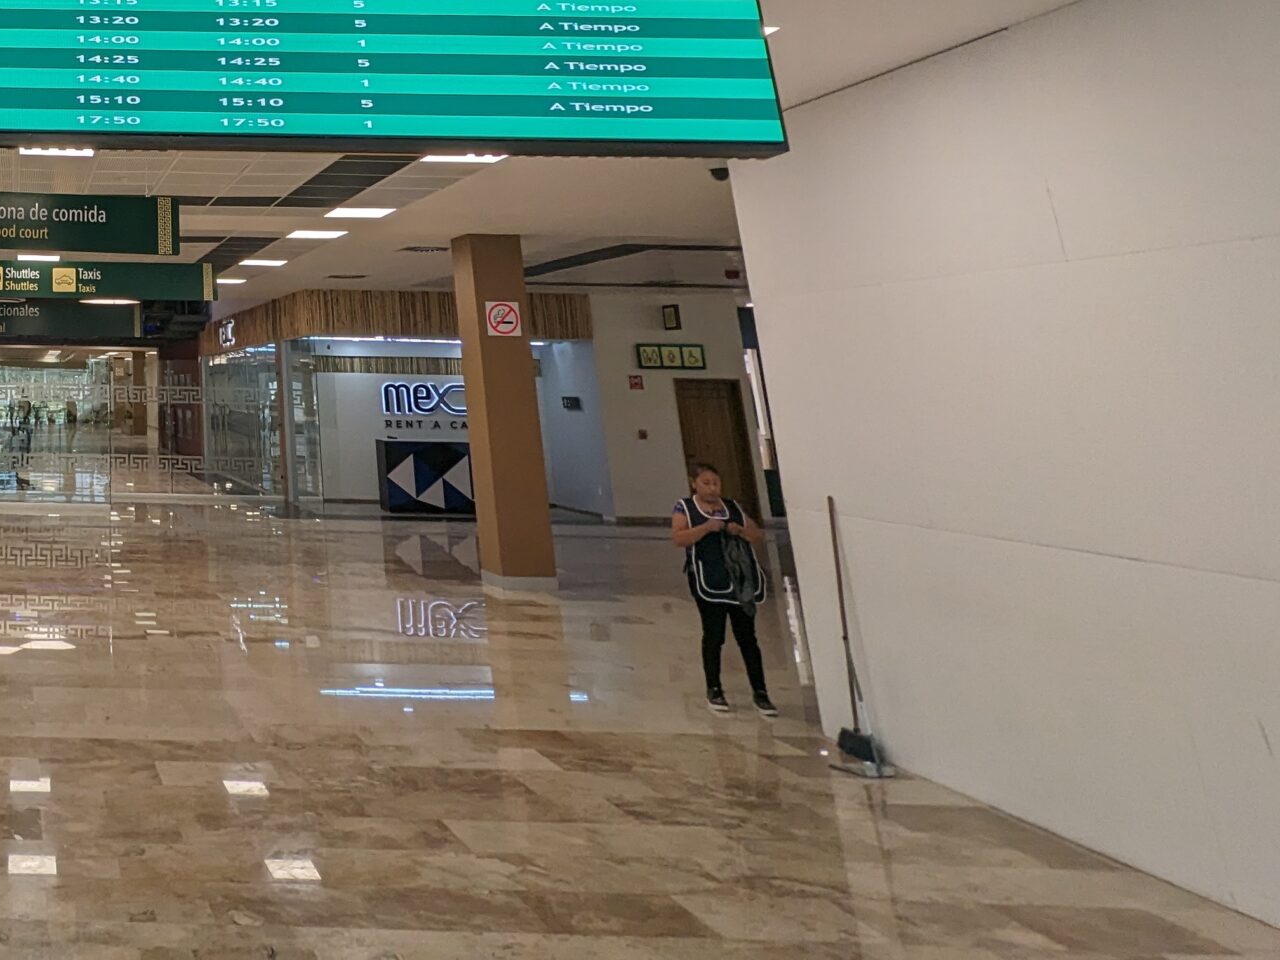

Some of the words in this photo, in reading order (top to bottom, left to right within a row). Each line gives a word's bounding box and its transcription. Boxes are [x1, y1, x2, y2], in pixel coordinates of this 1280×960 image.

[537, 2, 551, 12] A
[558, 2, 636, 14] Tiempo
[76, 15, 139, 25] 13:20
[216, 17, 279, 27] 13:20
[539, 21, 554, 31] A
[559, 21, 640, 34] Tiempo
[77, 34, 139, 44] 14:00
[217, 37, 280, 47] 14:00
[542, 41, 556, 50] A
[562, 41, 642, 53] Tiempo
[76, 54, 139, 64] 14:25
[217, 56, 280, 67] 14:25
[544, 61, 560, 70] A
[564, 61, 646, 73] Tiempo
[77, 74, 140, 84] 14:40
[219, 76, 282, 86] 14:40
[76, 94, 140, 105] 15:10
[219, 97, 283, 107] 15:10
[77, 115, 140, 125] 17:50
[220, 117, 284, 127] 17:50
[29, 202, 48, 221] de
[52, 202, 107, 224] comida
[19, 226, 49, 240] court
[5, 267, 40, 280] Shuttles
[78, 268, 102, 281] Taxis
[4, 280, 39, 292] Shuttles
[78, 283, 97, 294] Taxis
[384, 419, 423, 429] RENT
[450, 420, 469, 430] CA
